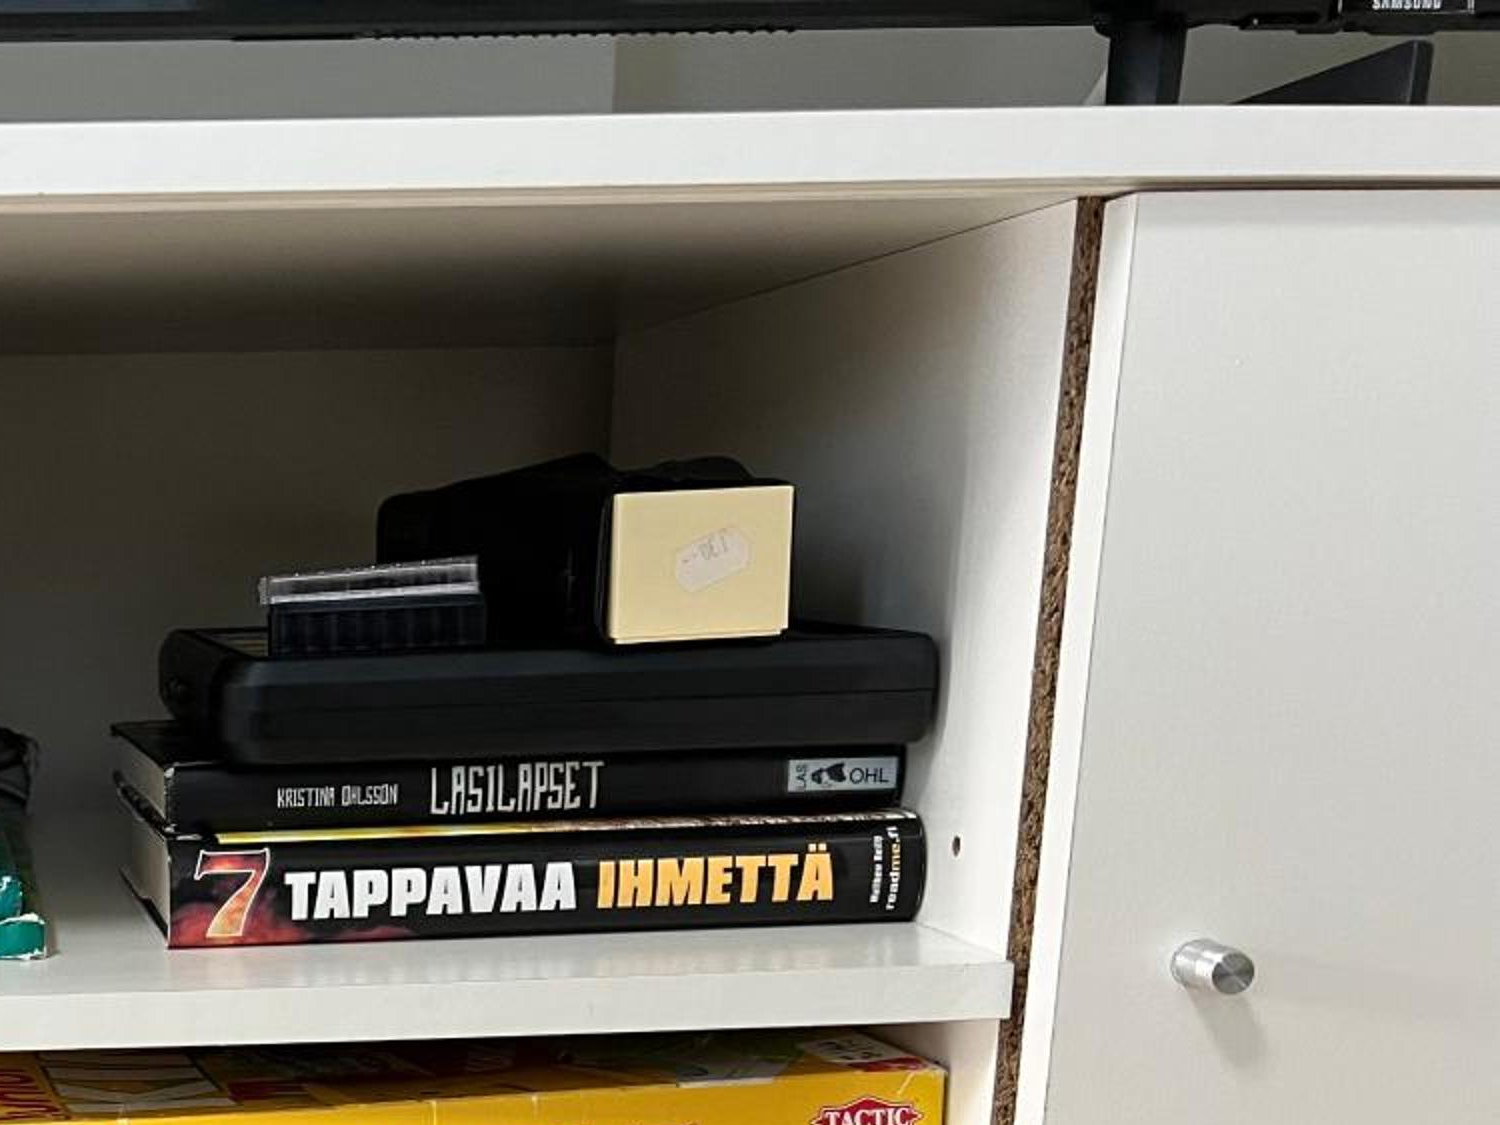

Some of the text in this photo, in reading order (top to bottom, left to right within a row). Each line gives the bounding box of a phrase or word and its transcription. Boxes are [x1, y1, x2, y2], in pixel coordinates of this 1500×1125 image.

[276, 761, 605, 815] KRISTINA OHLSSON LASILAPSET
[850, 767, 889, 784] OHL
[193, 842, 834, 940] 7 TAPPAVAA IHMETTÄ
[885, 826, 901, 911] readme.fi
